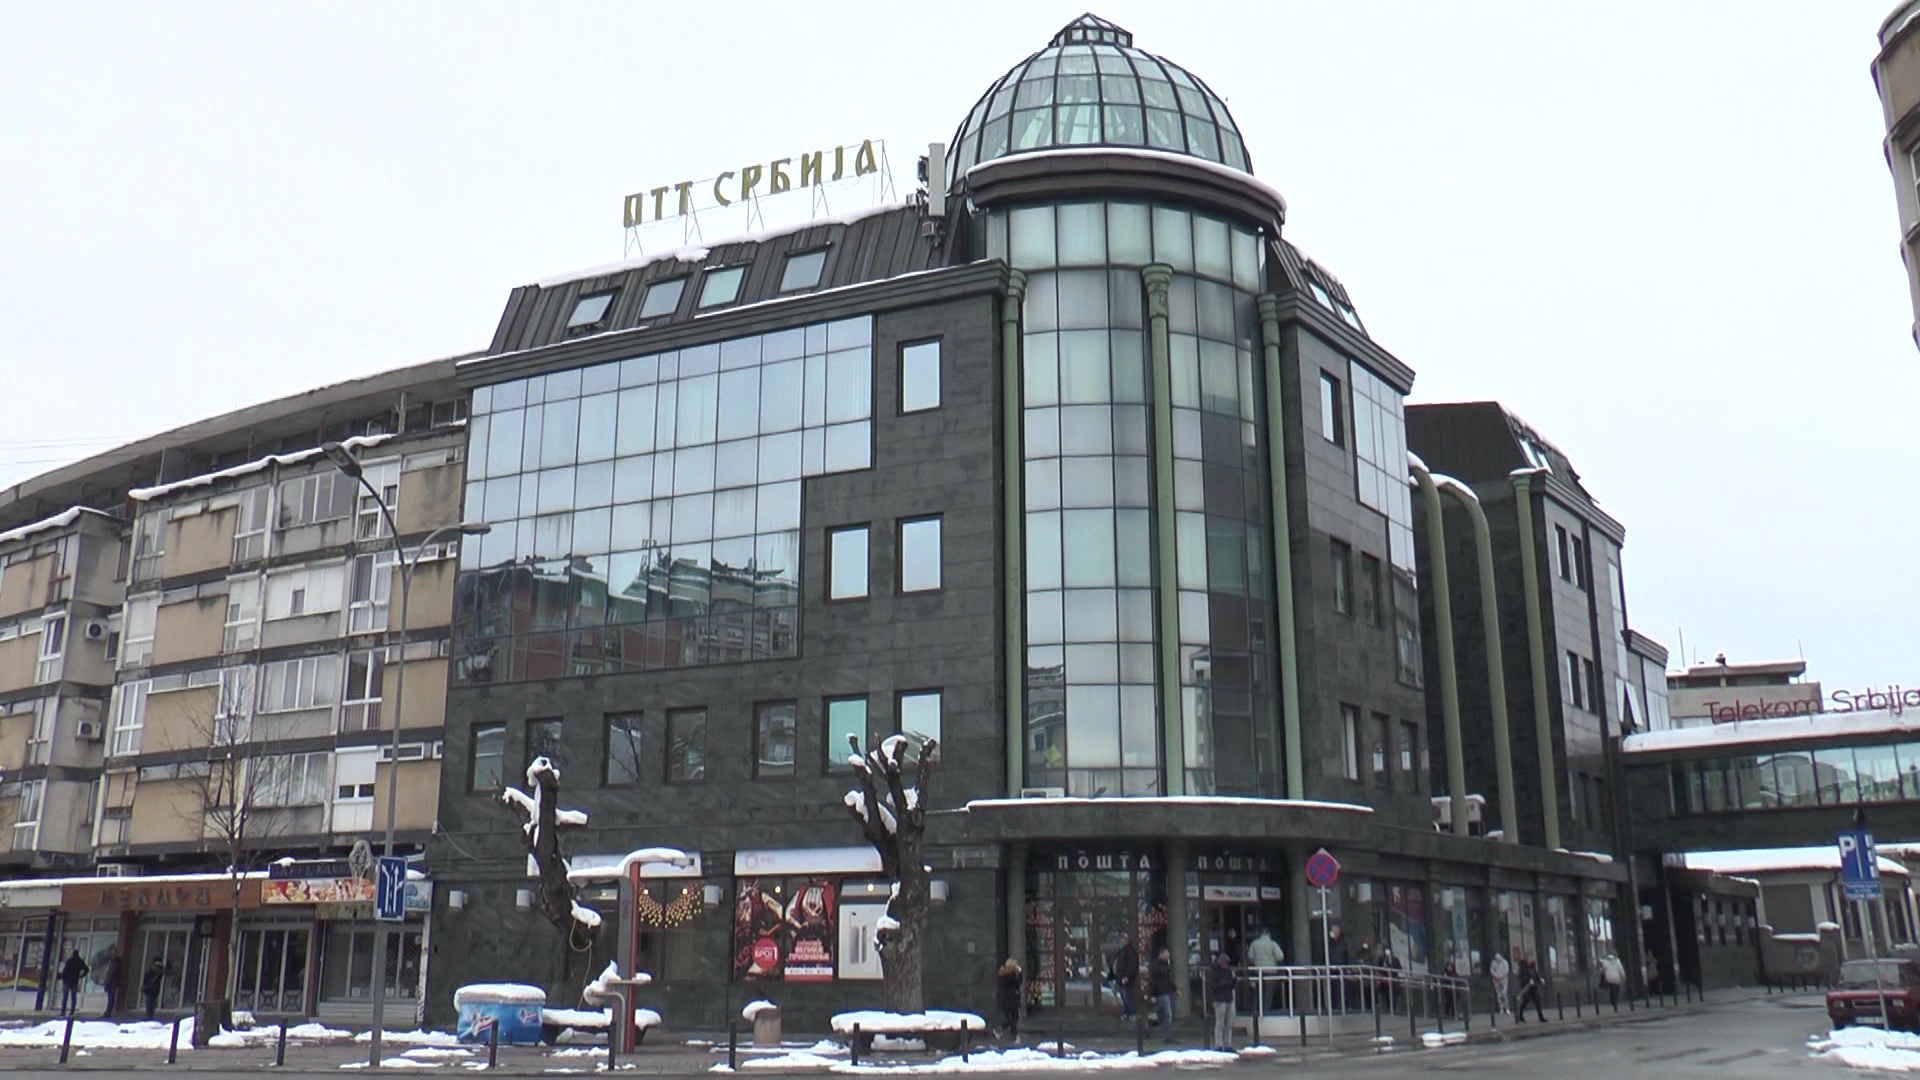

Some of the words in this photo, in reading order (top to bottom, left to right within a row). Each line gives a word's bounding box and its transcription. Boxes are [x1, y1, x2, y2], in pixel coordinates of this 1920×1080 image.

[623, 180, 693, 229] ПТТ
[713, 138, 878, 207] СРБИЈА
[1703, 697, 1824, 725] Telekom
[1838, 834, 1856, 858] P
[1057, 853, 1151, 870] ПОШТА
[1197, 855, 1267, 871] ПОШТА
